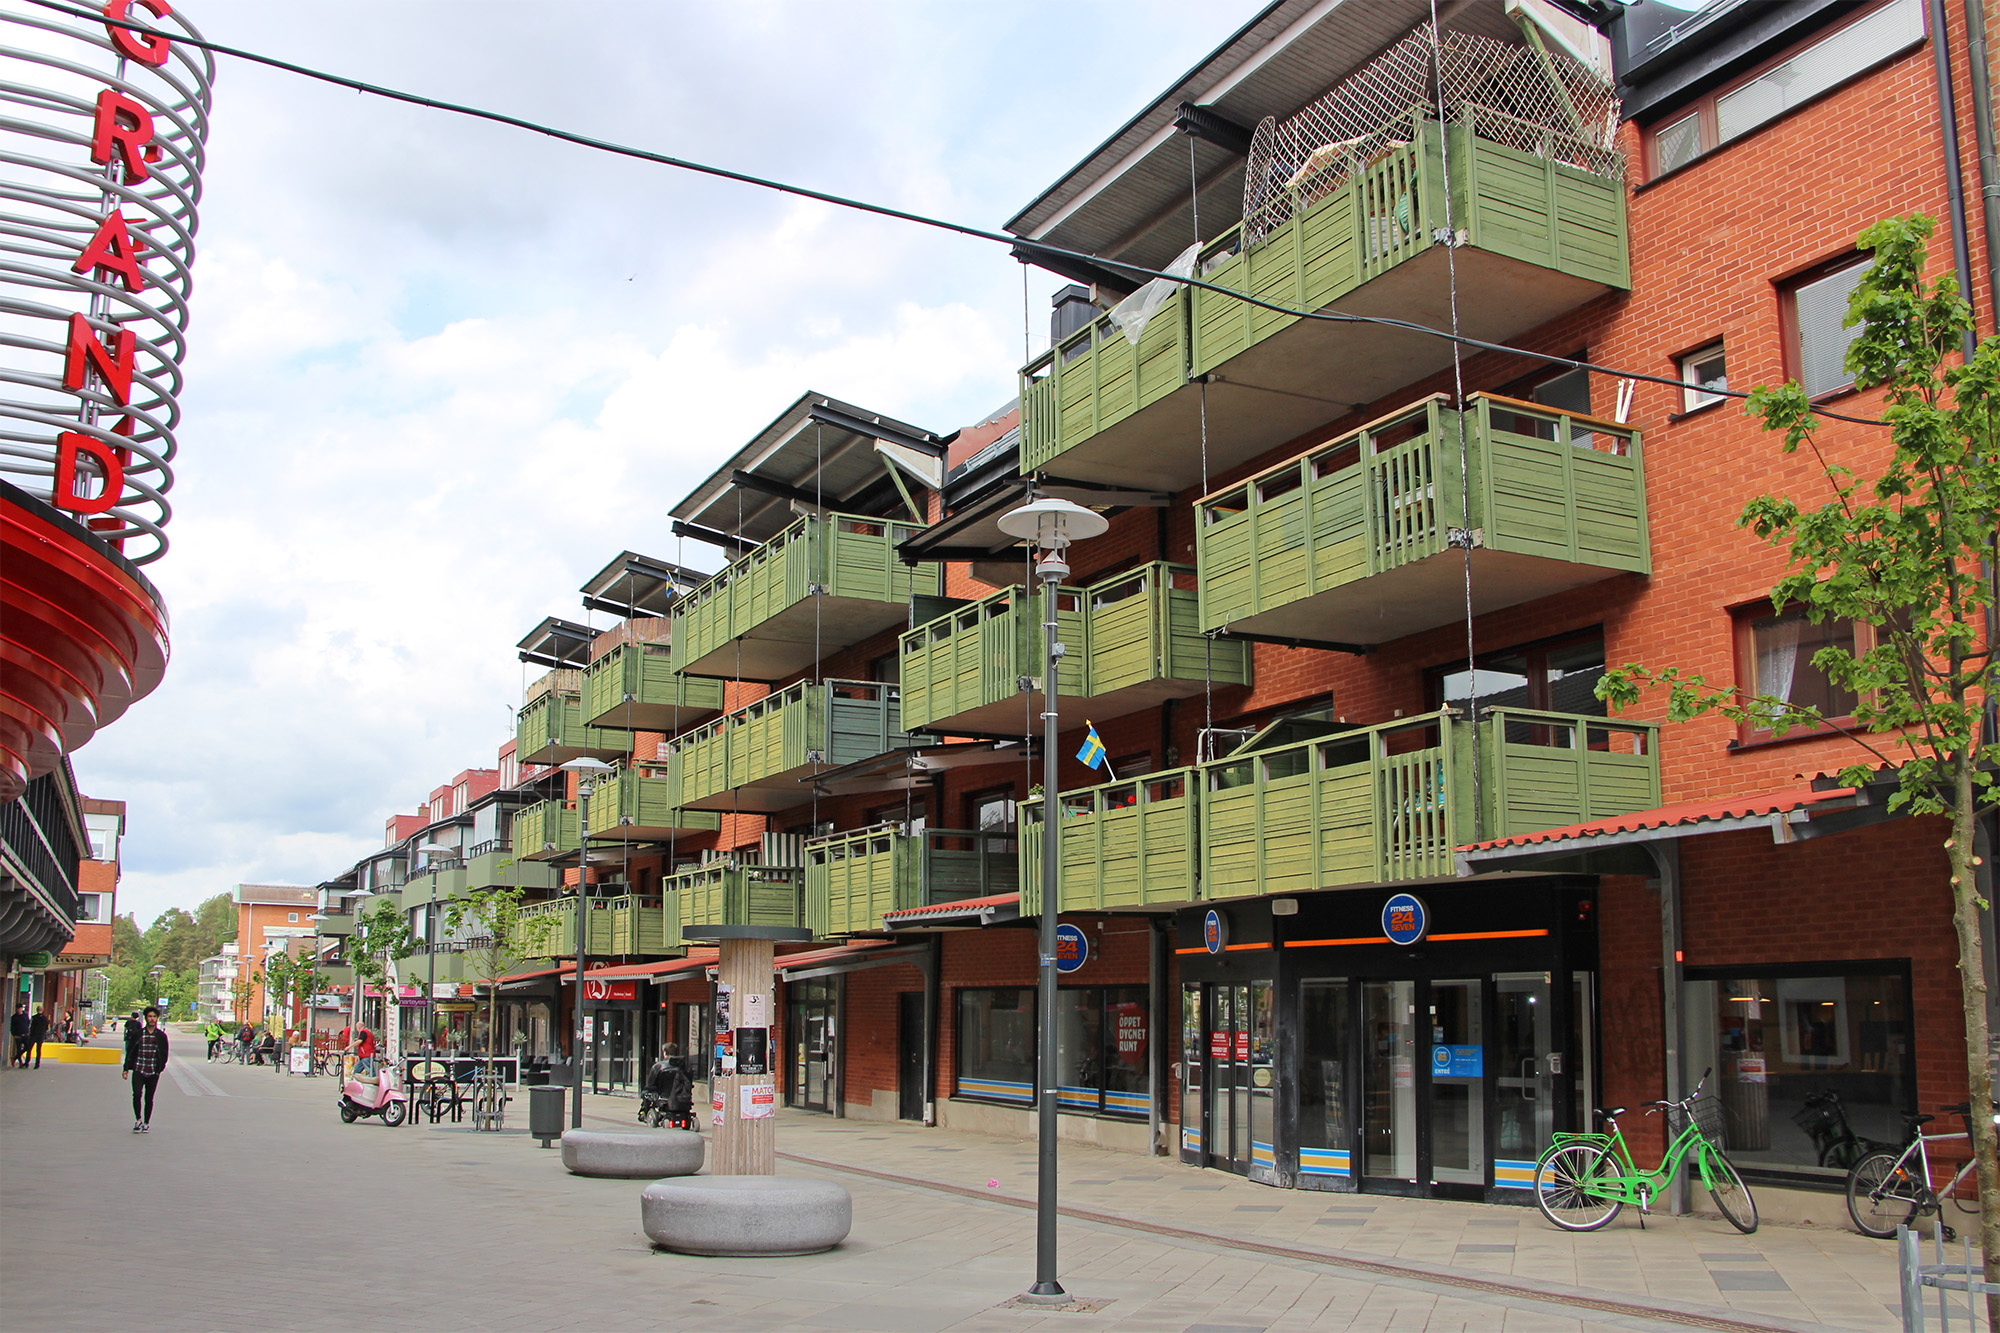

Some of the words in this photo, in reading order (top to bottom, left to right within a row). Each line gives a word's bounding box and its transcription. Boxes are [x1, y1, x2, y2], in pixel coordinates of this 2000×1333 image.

[51, 0, 172, 514] GRAND
[1391, 911, 1415, 924] 24
[1391, 923, 1415, 931] SEVEN
[1057, 941, 1078, 952] 24
[1119, 1013, 1141, 1028] ÖPPET
[1119, 1029, 1146, 1040] DYGNET
[1119, 1041, 1137, 1051] RUNT
